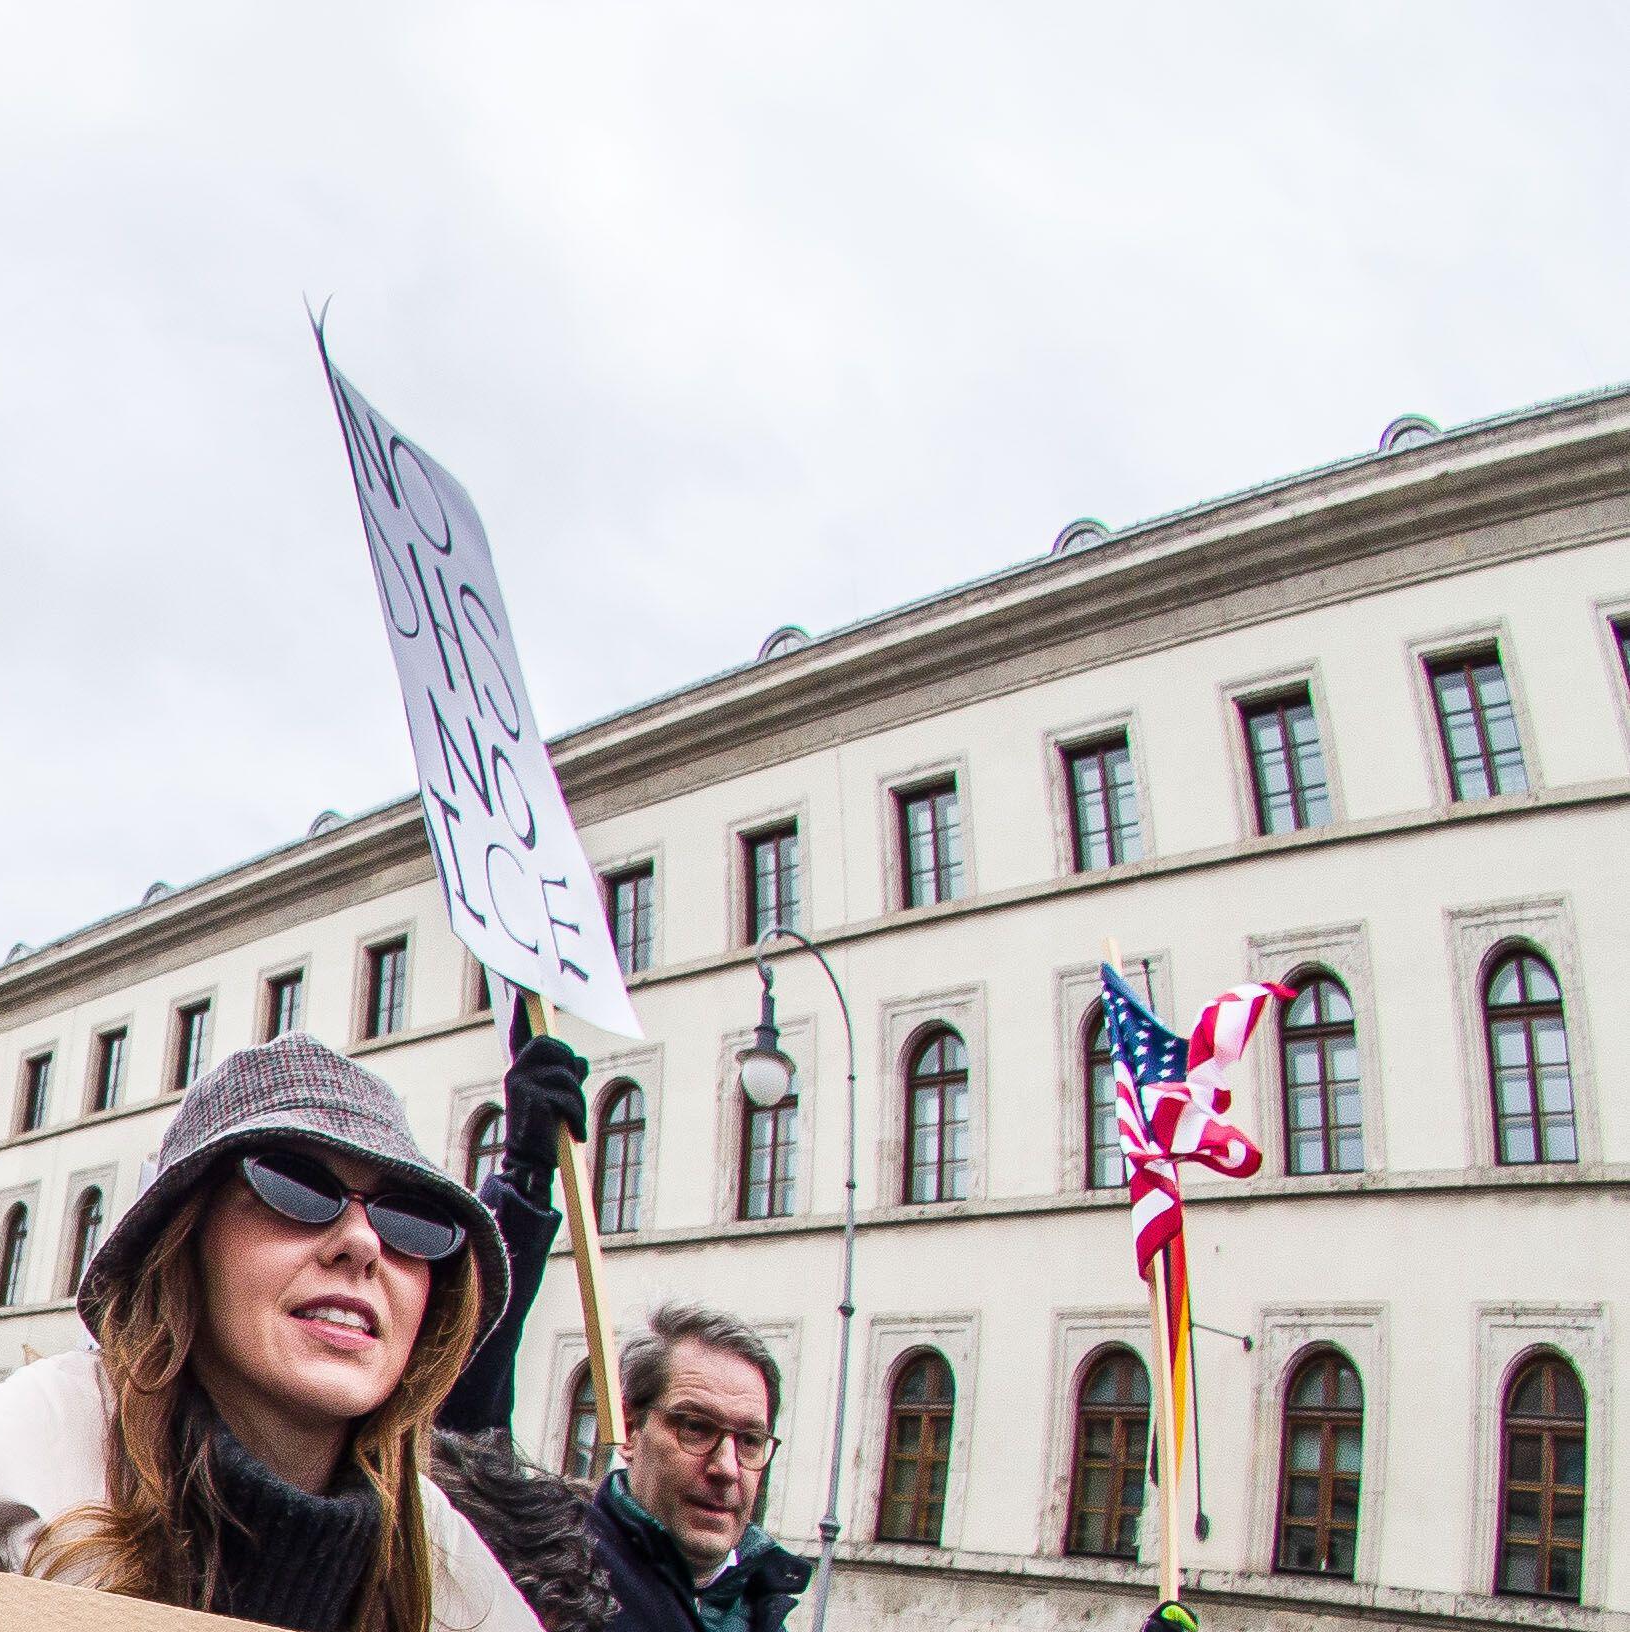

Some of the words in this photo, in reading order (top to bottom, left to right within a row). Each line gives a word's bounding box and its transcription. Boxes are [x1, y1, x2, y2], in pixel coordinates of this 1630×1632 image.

[335, 375, 453, 556] NO
[427, 685, 537, 852] NO
[426, 779, 589, 983] ICE
